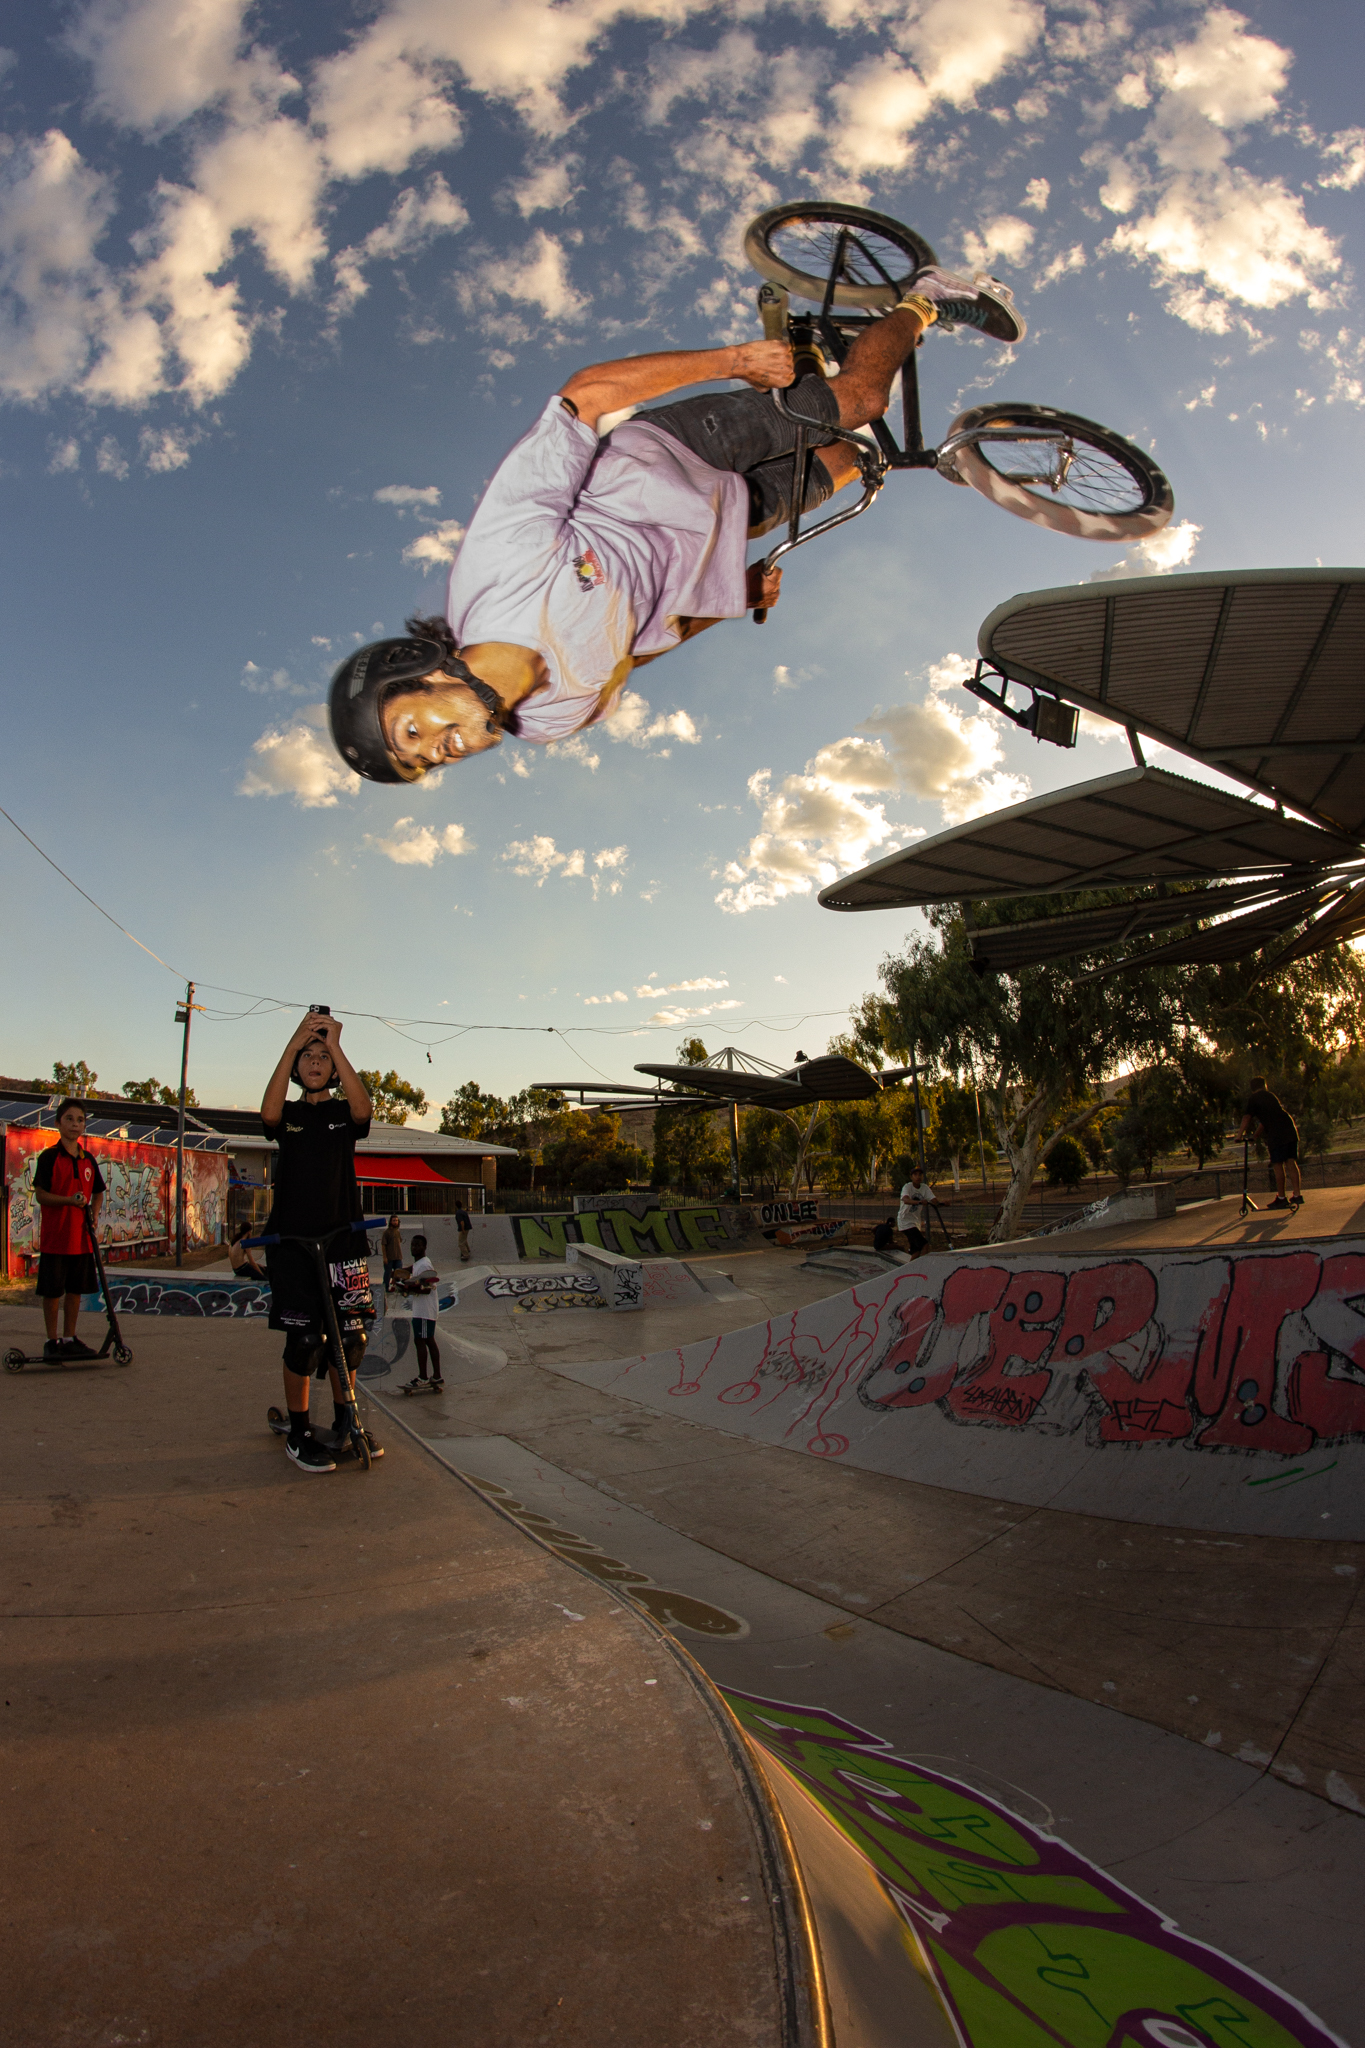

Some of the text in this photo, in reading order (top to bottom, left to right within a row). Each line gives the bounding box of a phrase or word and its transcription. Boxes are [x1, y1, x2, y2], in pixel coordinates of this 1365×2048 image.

[761, 1200, 818, 1225] ONLEE
[485, 1275, 600, 1299] ZERONE
[344, 1319, 362, 1327] 187
